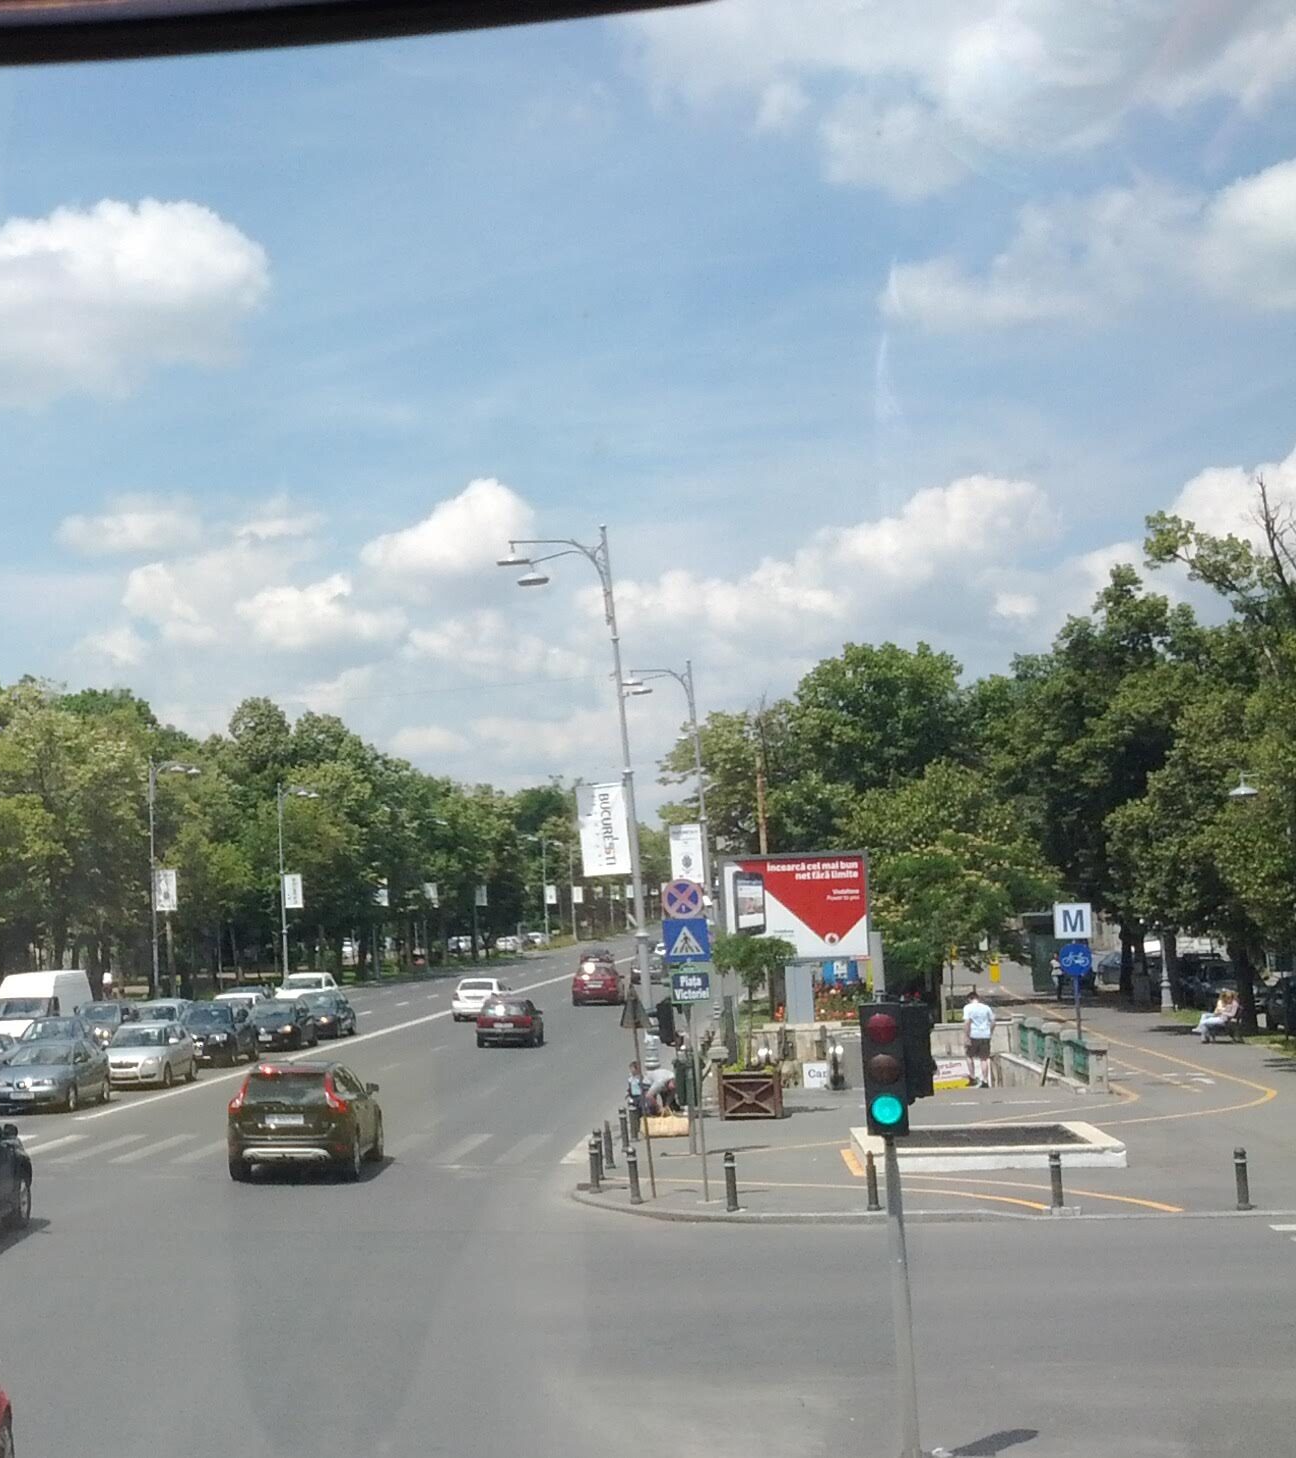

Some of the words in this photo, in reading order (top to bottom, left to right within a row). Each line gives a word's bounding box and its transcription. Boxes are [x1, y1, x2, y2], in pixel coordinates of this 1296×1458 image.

[807, 862, 821, 871] cel
[822, 861, 839, 870] mai
[840, 861, 858, 869] bun
[795, 872, 811, 880] net
[831, 870, 859, 878] limite
[1062, 909, 1085, 933] M
[674, 987, 710, 1000] Victoriei
